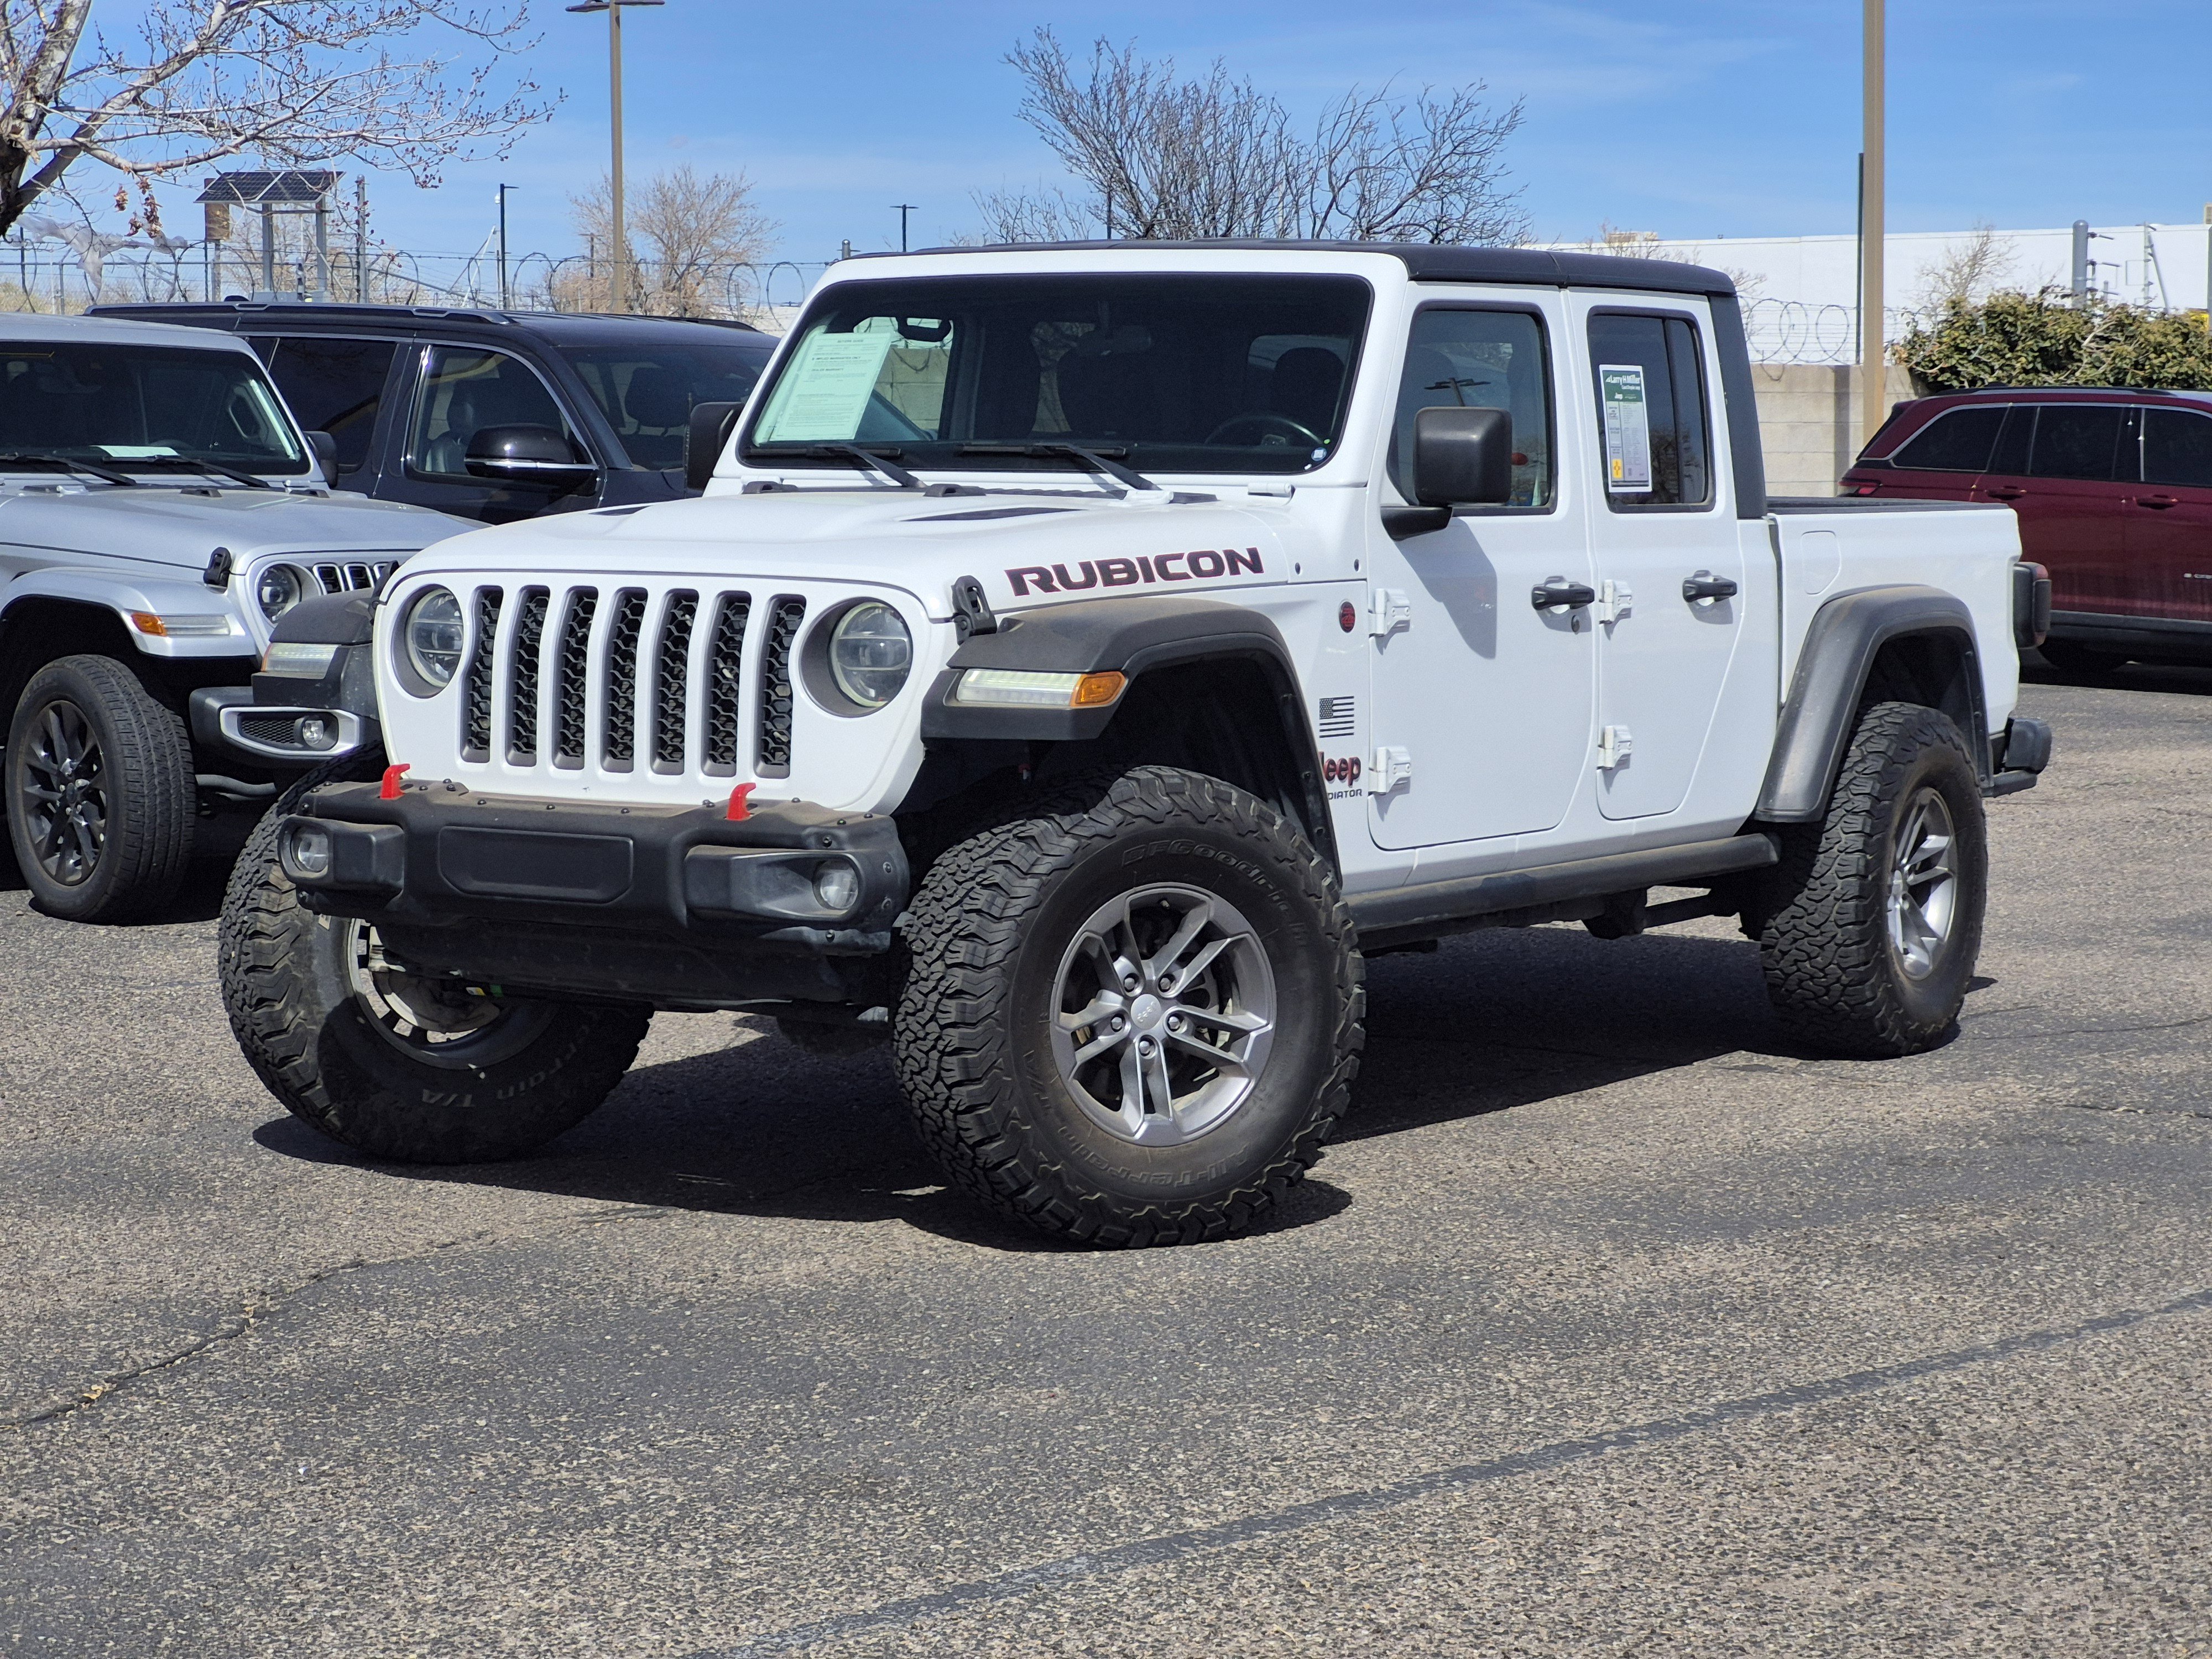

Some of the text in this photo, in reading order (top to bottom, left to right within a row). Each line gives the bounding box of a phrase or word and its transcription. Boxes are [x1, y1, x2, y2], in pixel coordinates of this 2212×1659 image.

[1004, 547, 1264, 597] RUBICON
[1327, 789, 1363, 800] DIATOR
[1121, 838, 1307, 946] BFGoodrich
[422, 1088, 476, 1108] T/A
